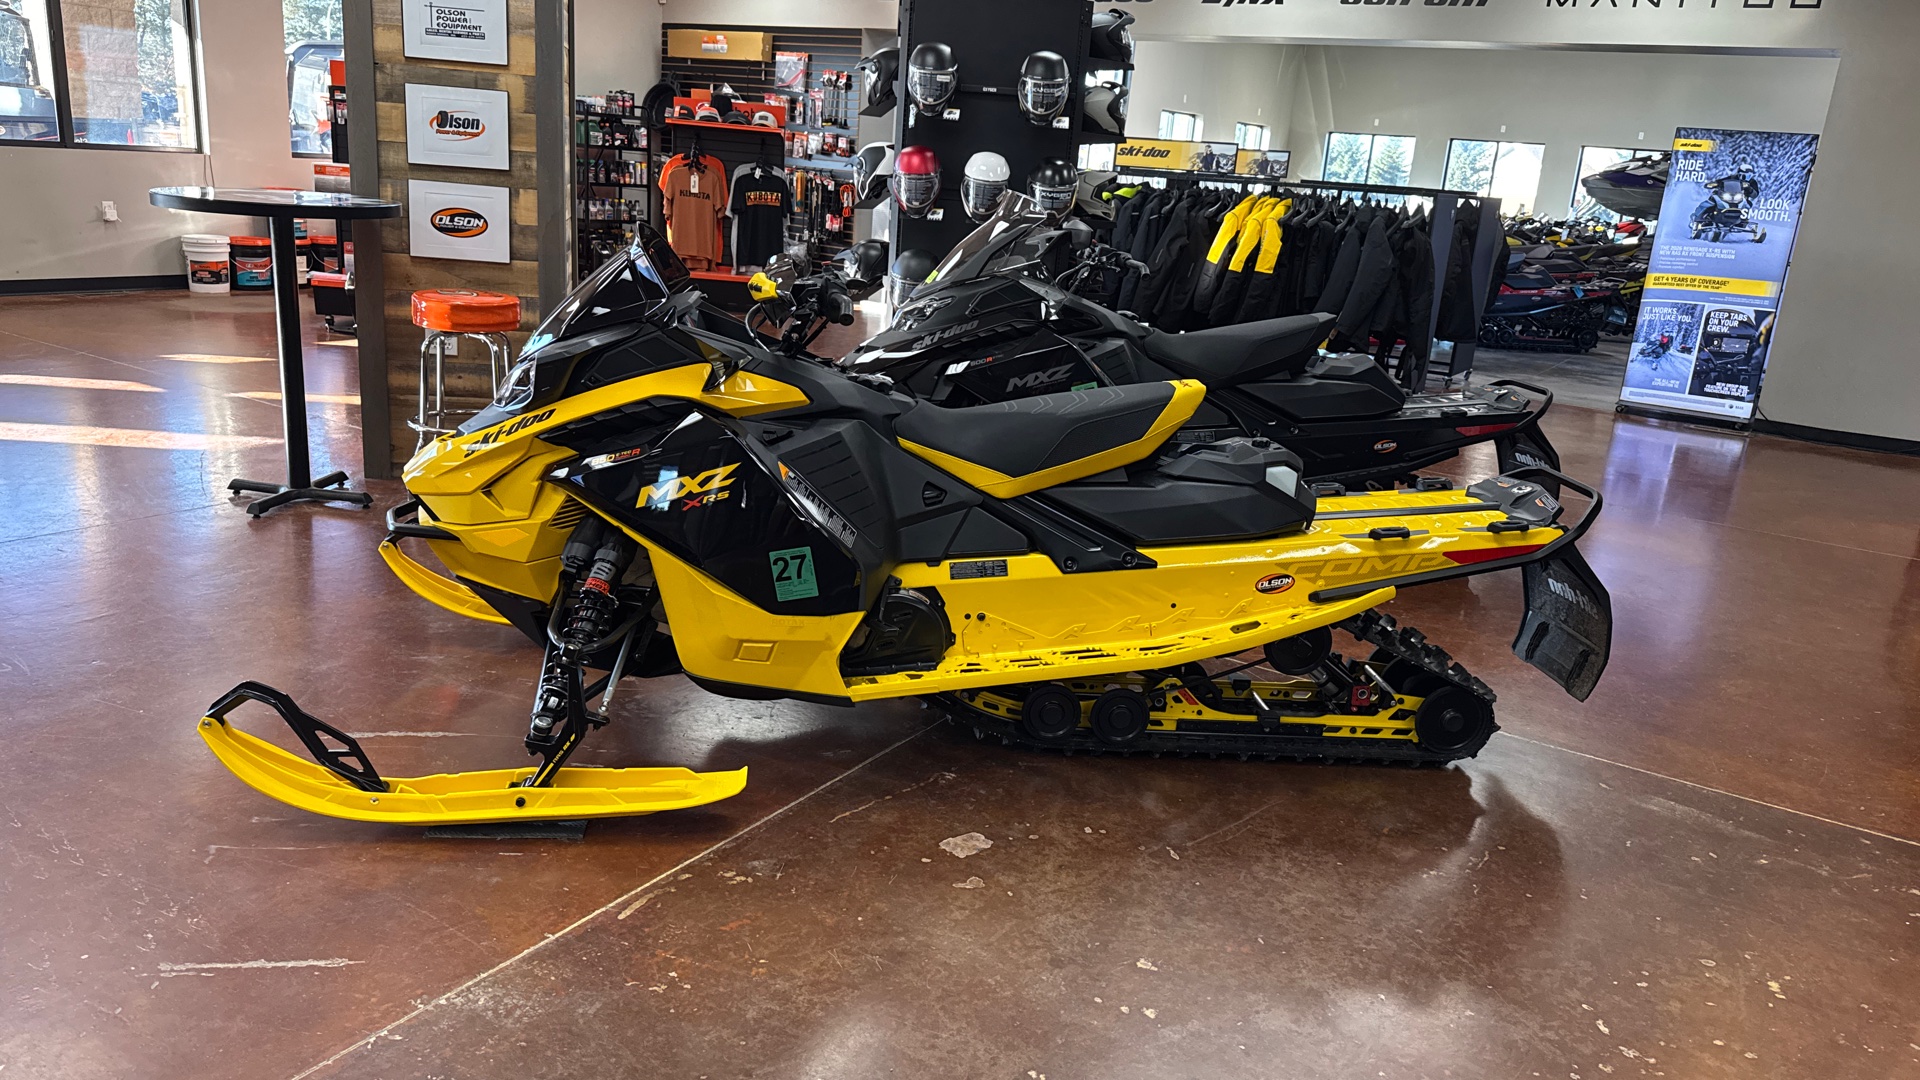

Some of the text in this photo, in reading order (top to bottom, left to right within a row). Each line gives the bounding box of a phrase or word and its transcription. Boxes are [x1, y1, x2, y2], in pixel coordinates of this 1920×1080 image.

[436, 9, 466, 17] OLSON
[436, 15, 468, 24] POWER
[436, 22, 483, 31] EQUIPMENT
[436, 110, 480, 130] Olson
[1117, 145, 1171, 159] ski-doo
[1677, 159, 1704, 171] RIDE
[1675, 170, 1708, 183] HARD.
[748, 190, 781, 202] KUBOTA
[1760, 198, 1791, 211] LOOK
[1740, 208, 1791, 222] SMOOTH.
[435, 215, 484, 228] OLSON
[1705, 252, 1735, 260] SUSPENSION
[1652, 307, 1679, 315] WORKS.
[1710, 311, 1748, 321] KEEP TABS
[1677, 315, 1692, 323] YOU.
[1709, 318, 1739, 328] ON YOUR
[1707, 325, 1730, 333] CREW.
[912, 320, 979, 351] ski-doo
[1005, 362, 1076, 393] MXZ
[464, 408, 556, 458] ski-doo
[1374, 442, 1397, 450] OLSON
[635, 462, 742, 509] MXZ
[772, 554, 807, 583] 27
[1289, 552, 1447, 577] COMP
[1258, 577, 1293, 588] OLSON
